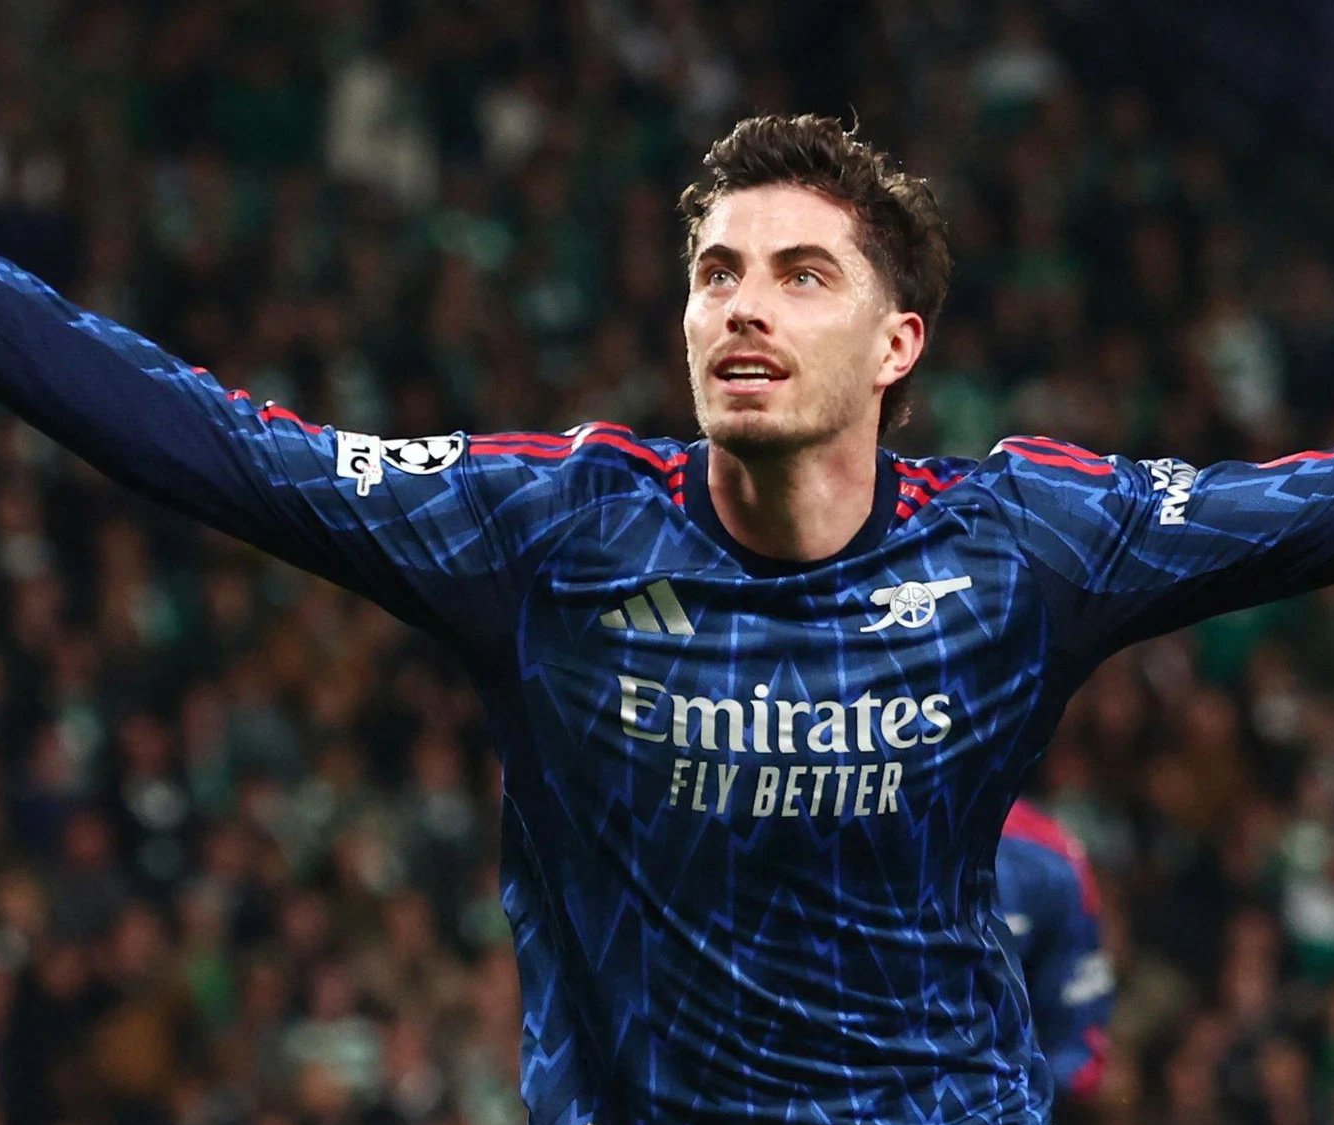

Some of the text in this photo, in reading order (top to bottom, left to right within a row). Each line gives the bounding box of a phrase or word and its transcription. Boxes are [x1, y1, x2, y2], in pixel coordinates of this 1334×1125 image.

[617, 675, 953, 754] Emirates
[669, 758, 904, 818] FLY BETTER
